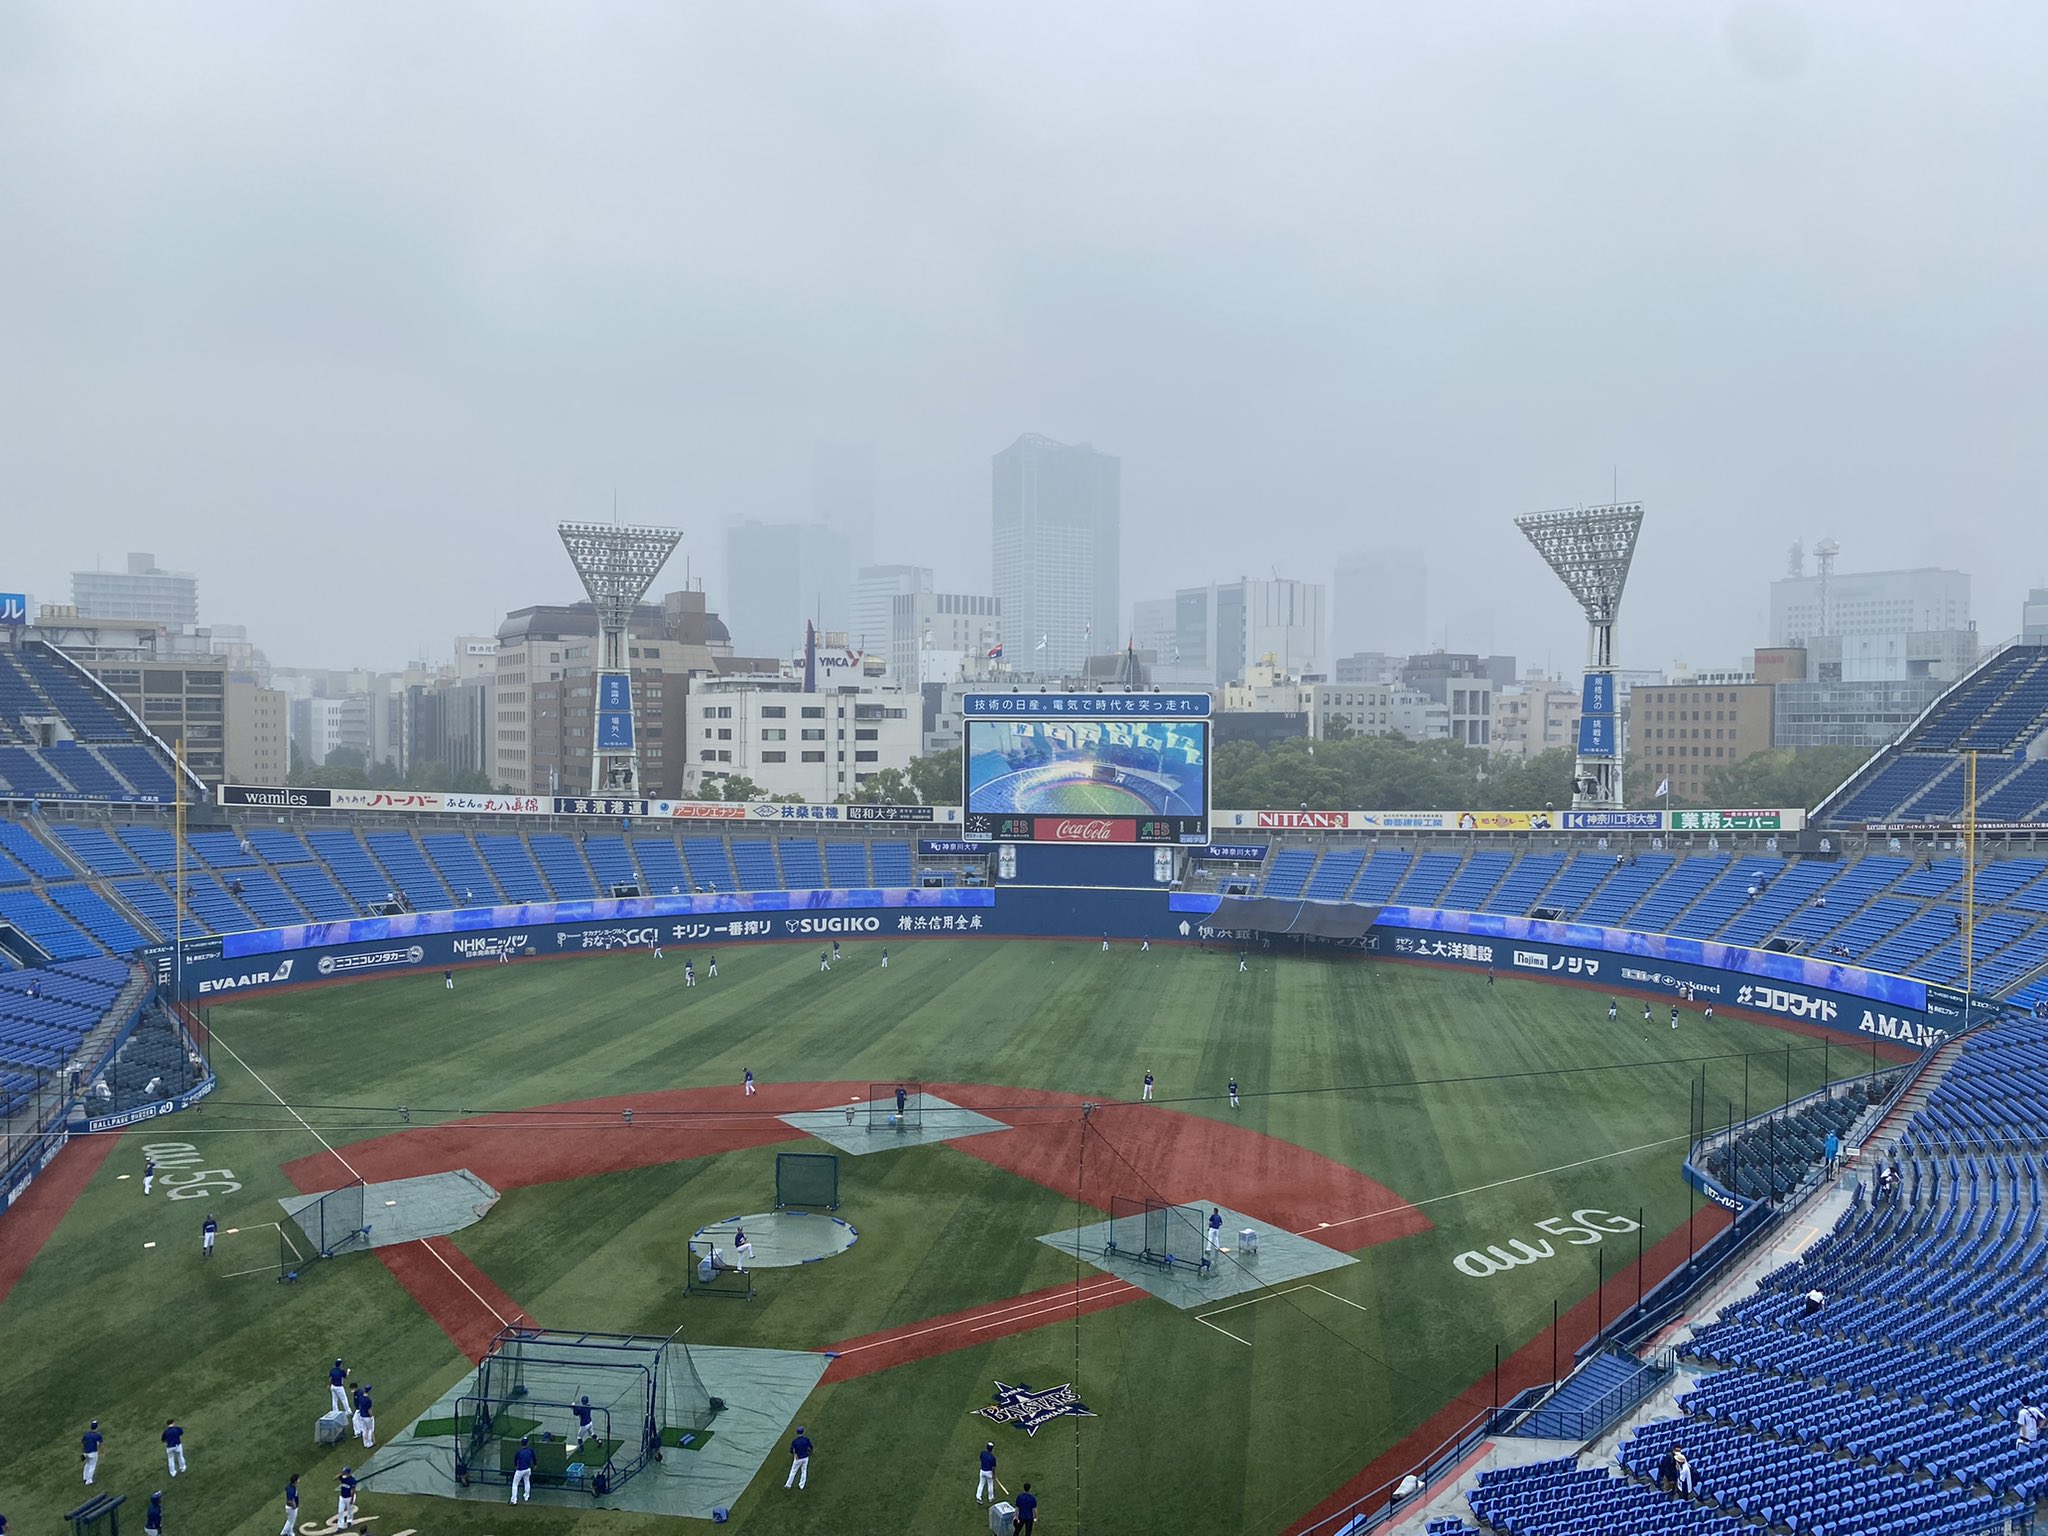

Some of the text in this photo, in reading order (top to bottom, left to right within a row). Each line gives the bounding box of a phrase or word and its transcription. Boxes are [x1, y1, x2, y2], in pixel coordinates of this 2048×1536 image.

[819, 657, 849, 667] YMCA
[974, 699, 1202, 712] 技術の日産。電気で時代を突っ走れ。
[1592, 678, 1603, 745] 規格外の 挑戦を
[245, 790, 308, 806] wamiles
[781, 805, 839, 819] 扶桑電機
[850, 803, 898, 819] 昭和大学
[1587, 813, 1657, 825] 神奈川工科大学
[1259, 813, 1328, 827] NITTAN
[1681, 812, 1775, 829] 業務スーパー
[1056, 820, 1112, 839] Coca-Cola
[942, 843, 978, 851] 神奈川大学
[1222, 848, 1259, 857] 神奈川大学
[672, 920, 771, 939] キリン一番搾り
[801, 917, 880, 933] SUGIKO
[897, 914, 983, 931] 横浜信用金庫
[465, 946, 515, 958] 日本発条株式社
[1431, 940, 1493, 963] 大洋建設
[336, 953, 406, 968] ニコニコレンタカー
[1551, 956, 1599, 976] ノジマ
[199, 972, 270, 993] EVA AIR
[1755, 986, 1838, 1022] コロワイド
[1453, 1209, 1646, 1277] au 5G
[980, 1389, 1081, 1424] BAYSTARS
